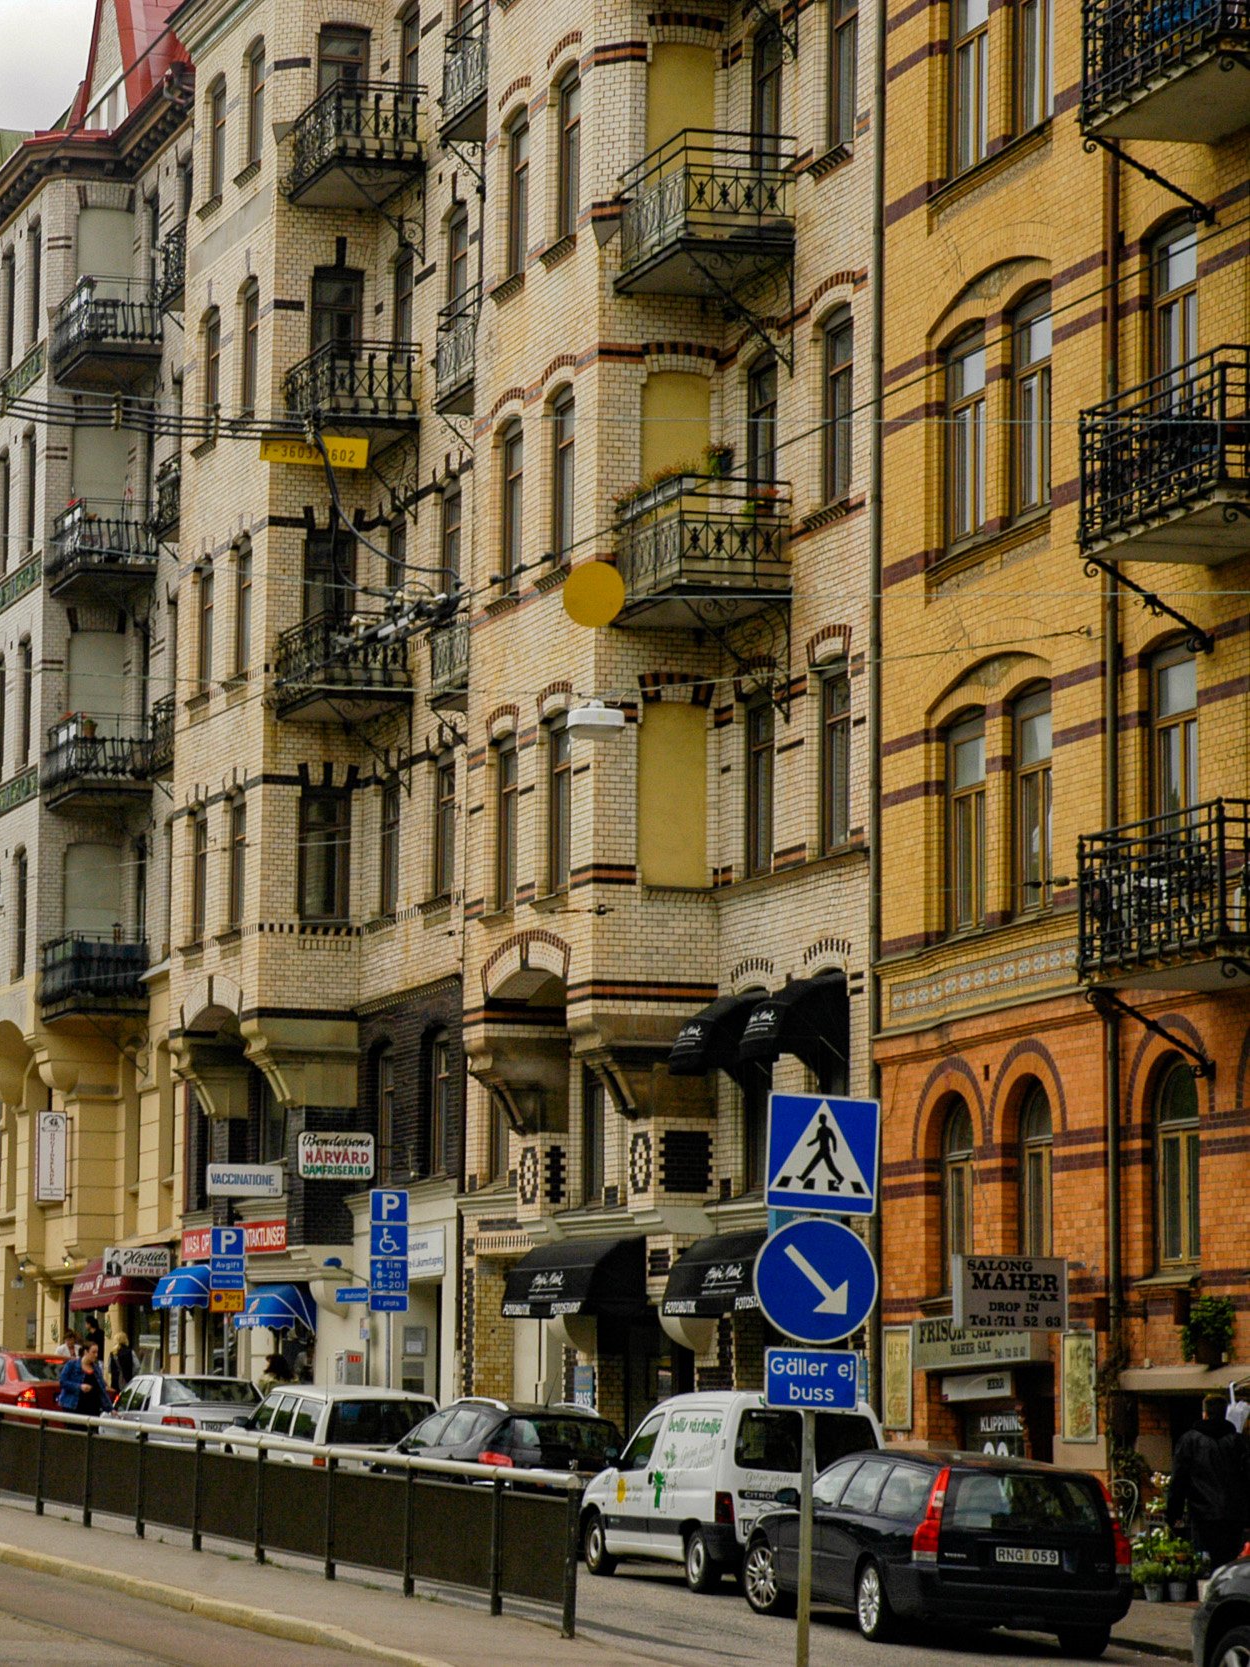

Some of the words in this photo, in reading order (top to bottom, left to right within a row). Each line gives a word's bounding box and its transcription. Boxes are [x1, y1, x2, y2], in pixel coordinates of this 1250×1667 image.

[305, 1148, 369, 1164] HÅRVÅRD
[302, 1165, 371, 1176] DAMFRISERING
[382, 1193, 400, 1220] P
[221, 1230, 237, 1253] P
[244, 1226, 286, 1248] NTAKTLINSER
[215, 1261, 240, 1270] Avgift
[967, 1259, 1033, 1272] SALONG
[372, 1281, 405, 1289] (8-20)
[971, 1273, 1059, 1292] MAHER
[1029, 1293, 1059, 1302] SAX
[664, 1300, 697, 1314] FOTOBUTIK
[988, 1302, 1021, 1312] DROP
[1026, 1303, 1040, 1313] IN
[1023, 1317, 1038, 1327] 52
[1045, 1317, 1061, 1328] 63
[770, 1357, 828, 1376] Gäller
[837, 1360, 854, 1381] ej
[789, 1382, 835, 1402] buss
[997, 1549, 1024, 1561] RNG
[1032, 1550, 1057, 1563] 059
